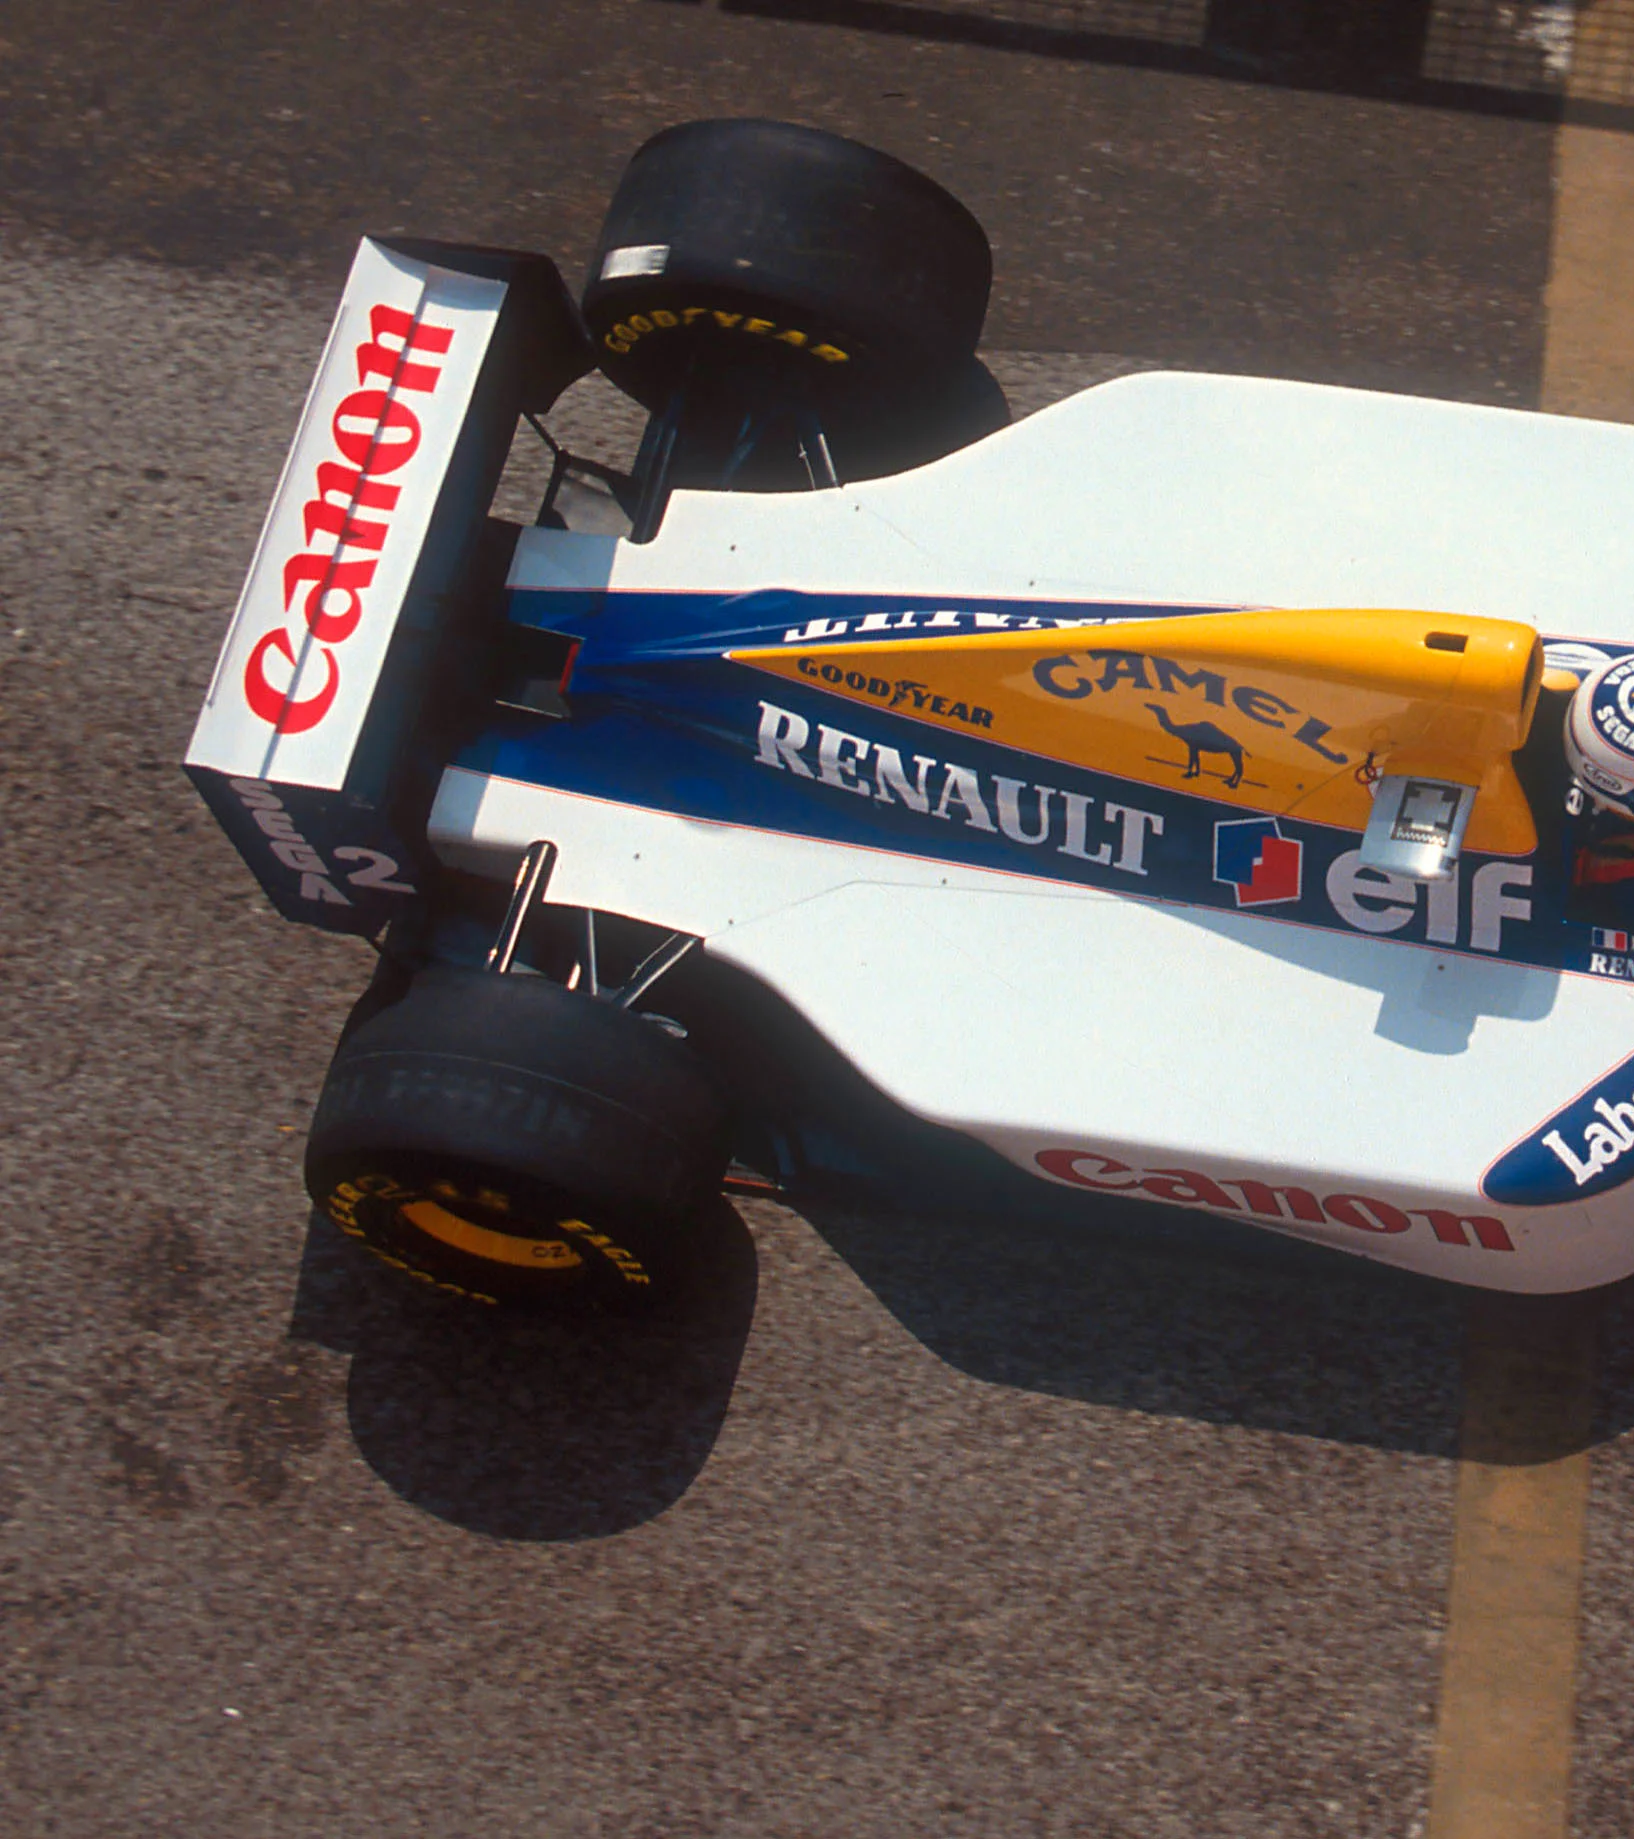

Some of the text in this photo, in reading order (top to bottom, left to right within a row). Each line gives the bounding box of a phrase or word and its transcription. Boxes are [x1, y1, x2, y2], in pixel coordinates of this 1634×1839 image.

[244, 303, 455, 735] Canon
[797, 656, 994, 729] GOODYEAR
[1032, 648, 1349, 765] CAMEL
[229, 778, 353, 906] SEGA
[754, 700, 1165, 876] RENAULT
[333, 845, 417, 894] 2
[1326, 848, 1534, 952] elf
[1034, 1148, 1516, 1252] Canon
